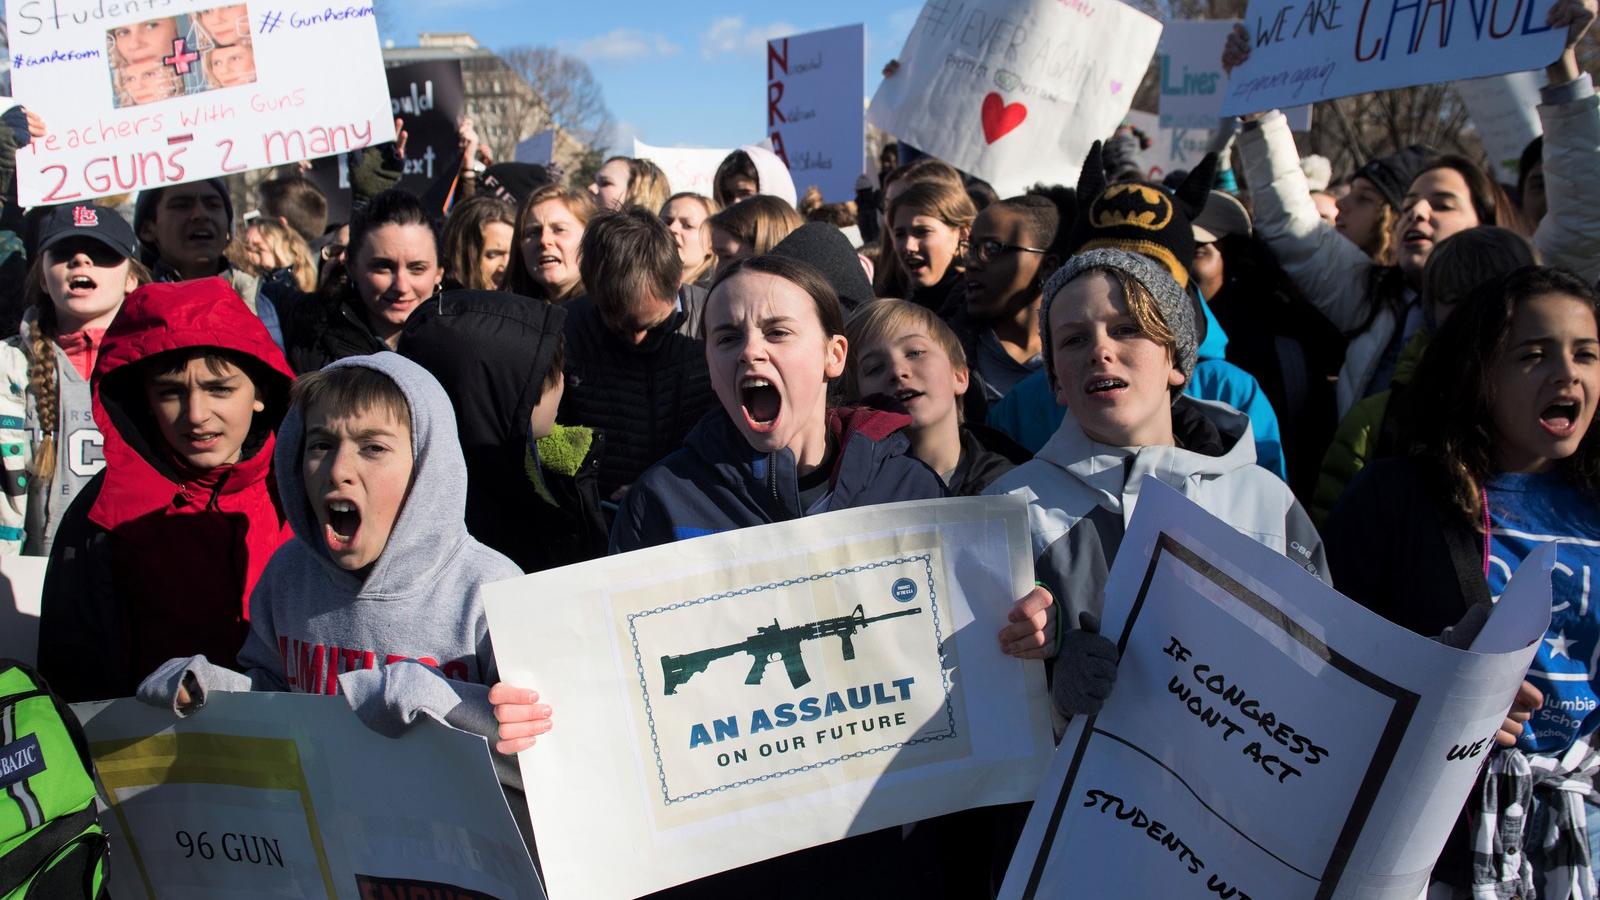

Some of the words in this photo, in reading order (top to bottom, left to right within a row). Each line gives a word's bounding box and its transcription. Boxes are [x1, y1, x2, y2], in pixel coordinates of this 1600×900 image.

[1256, 5, 1295, 48] WE
[1293, 0, 1344, 36] ARE
[1160, 55, 1220, 96] Lives
[392, 80, 434, 117] ould
[40, 163, 82, 202] 2
[215, 138, 248, 173] 2
[262, 119, 373, 165] many
[402, 145, 436, 179] ext
[689, 715, 740, 749] AN
[750, 677, 915, 735] ASSAULT
[1163, 636, 1192, 662] IF
[1193, 664, 1329, 764] CONGRESS
[1540, 709, 1583, 729] Scho
[1544, 693, 1597, 712] lumbia
[717, 748, 748, 767] ON
[759, 736, 806, 758] OUR
[816, 712, 907, 744] FUTURE
[1446, 737, 1487, 761] WE
[1243, 742, 1302, 783] ACT
[176, 830, 214, 860] 96
[221, 833, 284, 868] GUN
[1083, 789, 1205, 874] STUDENTS
